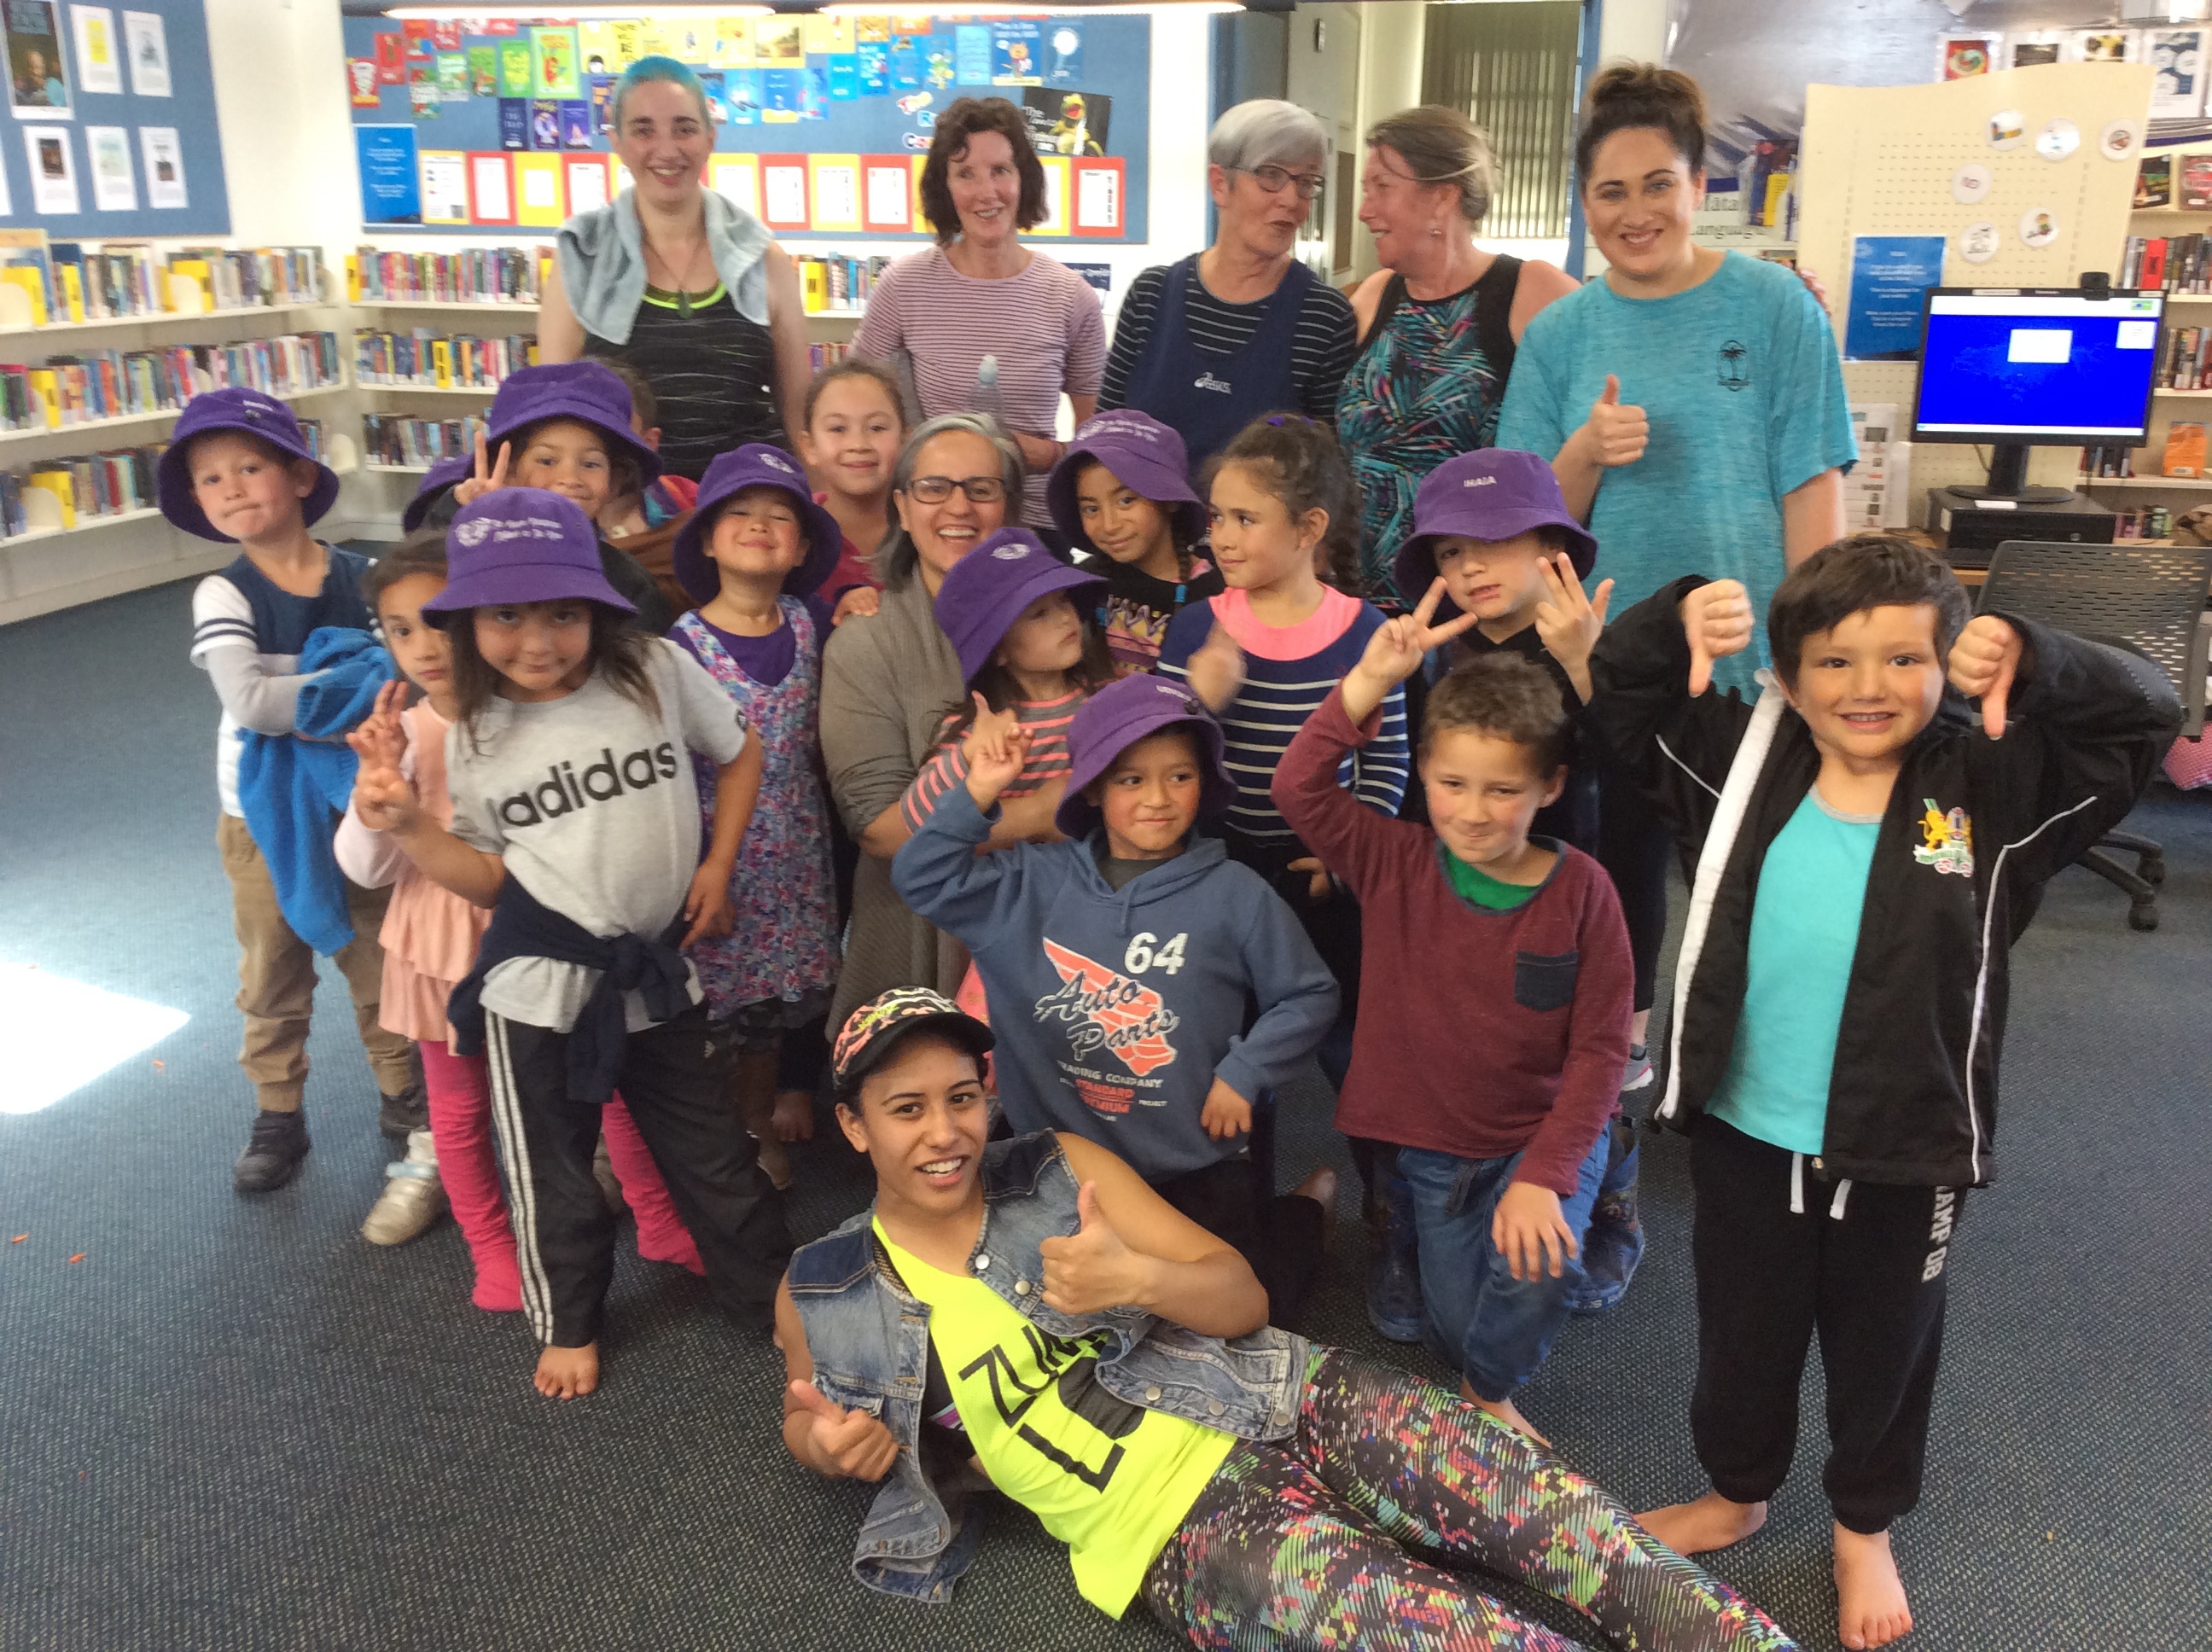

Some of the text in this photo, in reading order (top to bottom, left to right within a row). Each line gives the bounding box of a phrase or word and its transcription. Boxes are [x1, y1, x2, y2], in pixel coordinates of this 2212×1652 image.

[500, 741, 678, 828] adidas
[1125, 932, 1190, 974] 64
[1033, 969, 1141, 1023] Auto
[1067, 1009, 1181, 1062] Parts
[1106, 1073, 1164, 1088] COMPANY
